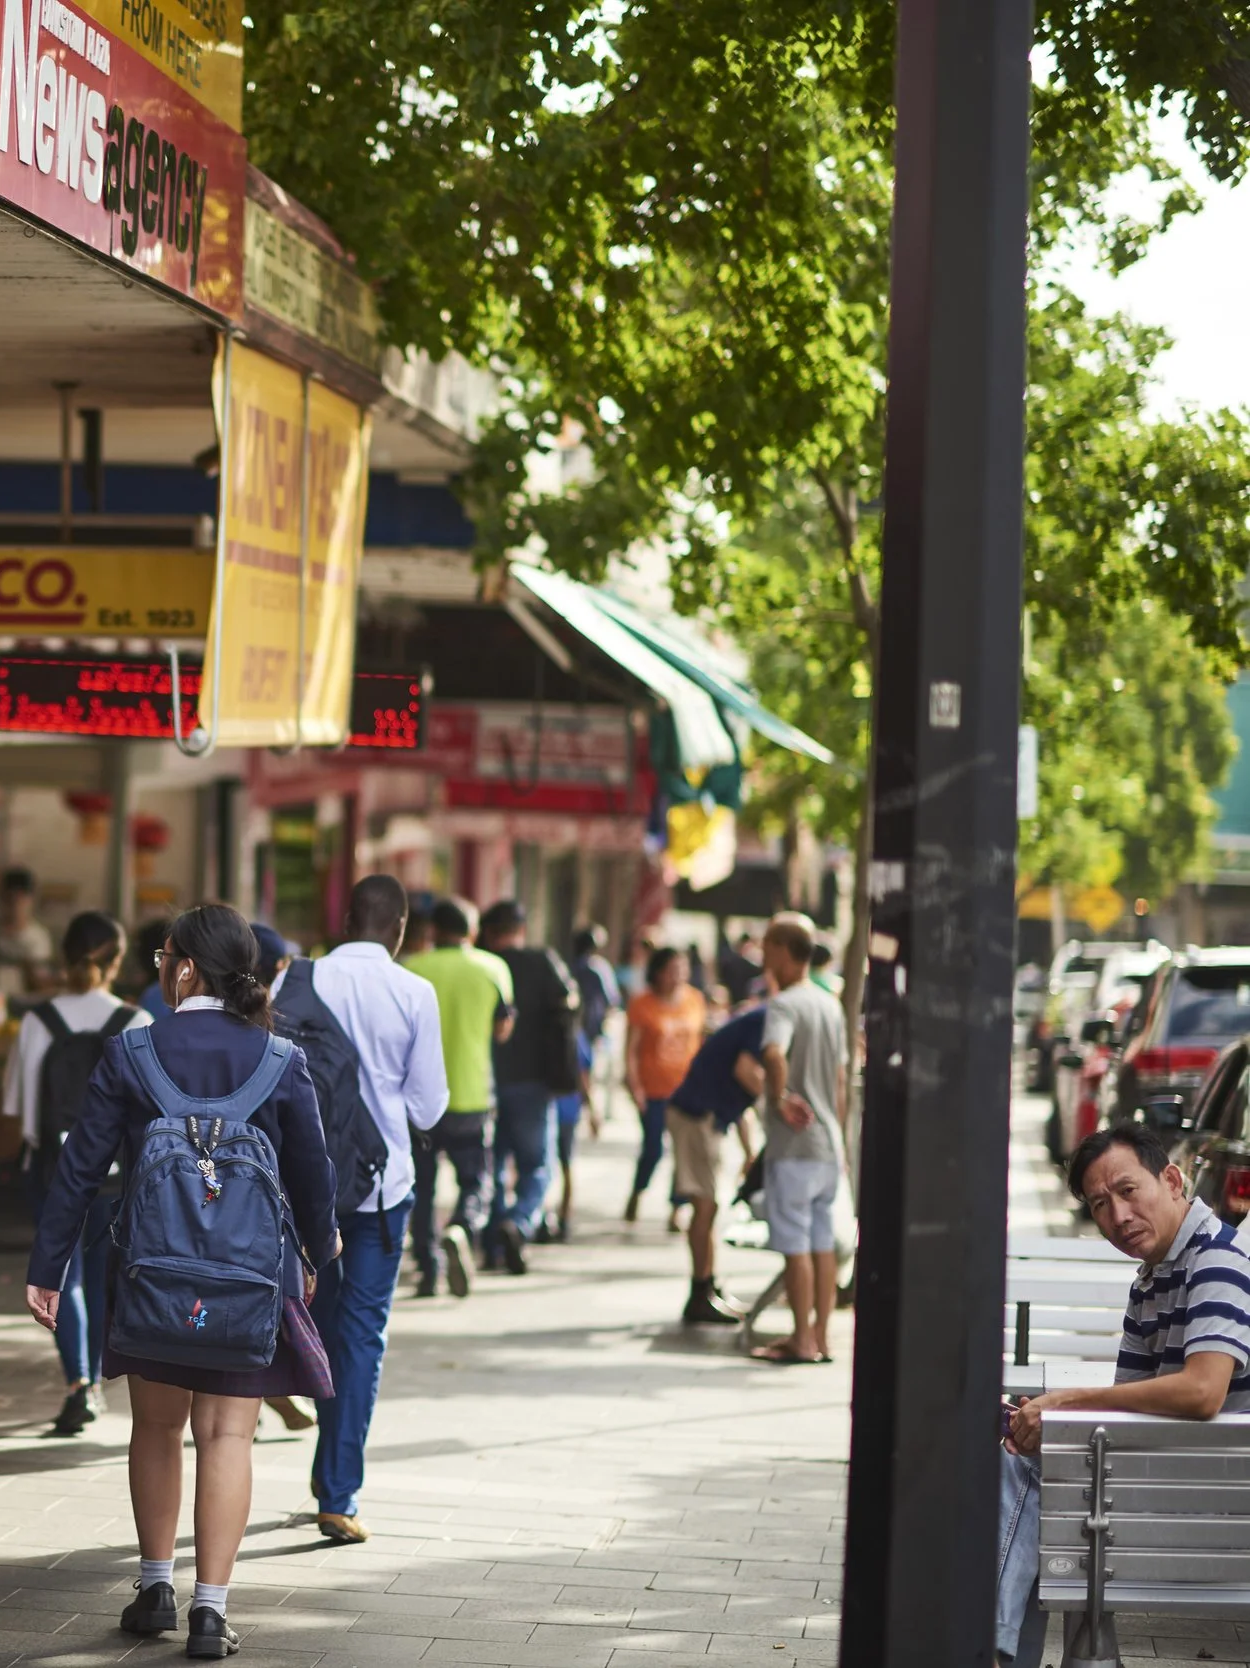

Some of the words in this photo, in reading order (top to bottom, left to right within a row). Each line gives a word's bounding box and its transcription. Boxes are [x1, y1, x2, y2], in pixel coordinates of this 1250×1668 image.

[120, 0, 163, 58] FROM
[165, 20, 202, 89] HERE
[97, 607, 139, 629] Est.
[147, 607, 194, 630] 1923
[188, 1316, 205, 1324] TCC
